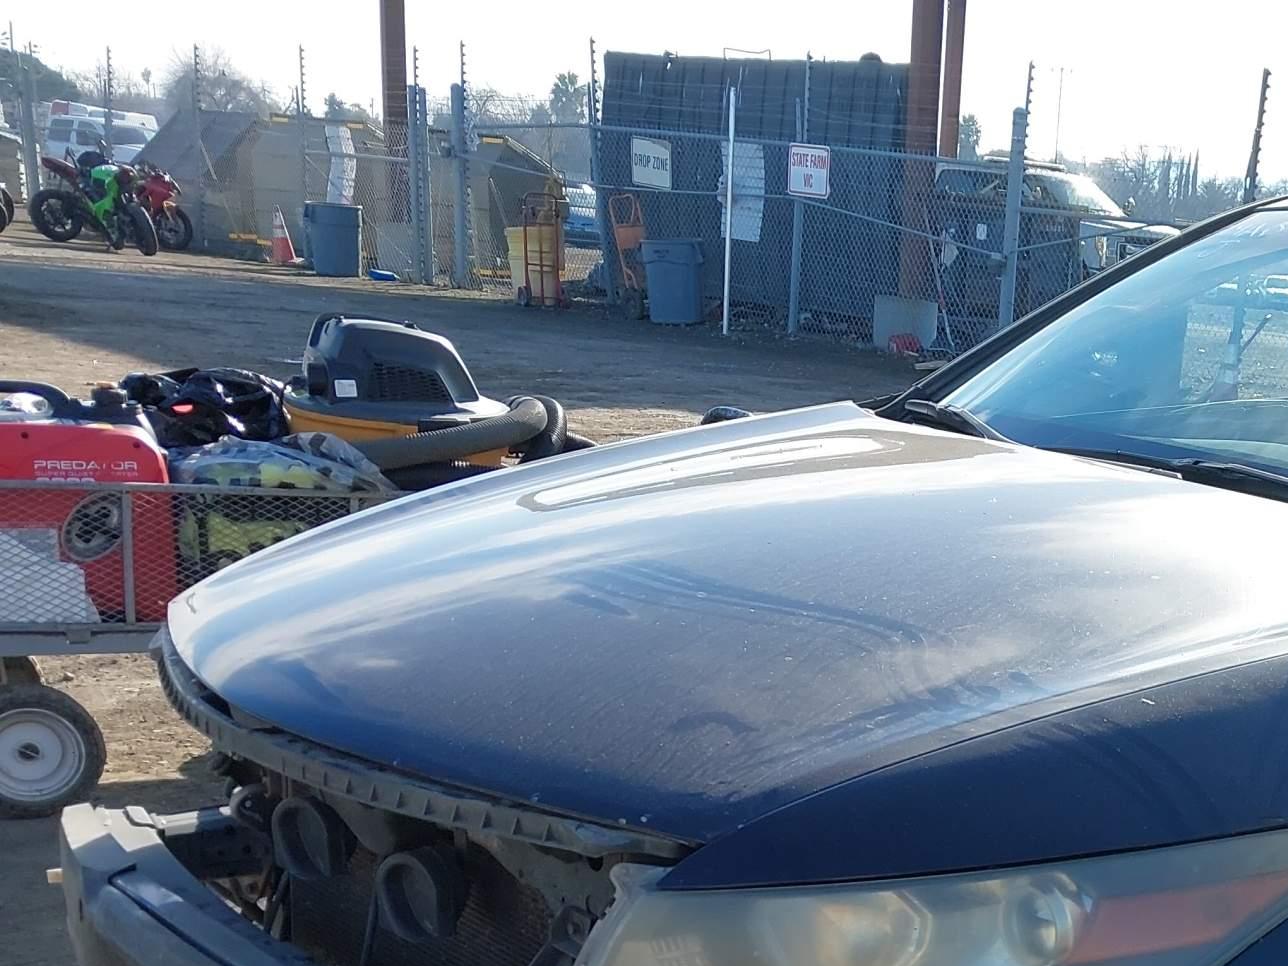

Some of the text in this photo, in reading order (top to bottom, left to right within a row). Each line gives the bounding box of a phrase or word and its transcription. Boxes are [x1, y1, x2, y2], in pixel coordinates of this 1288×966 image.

[634, 153, 669, 172] DROP ZONE
[792, 152, 828, 170] STATE FARM
[803, 173, 814, 188] VIC
